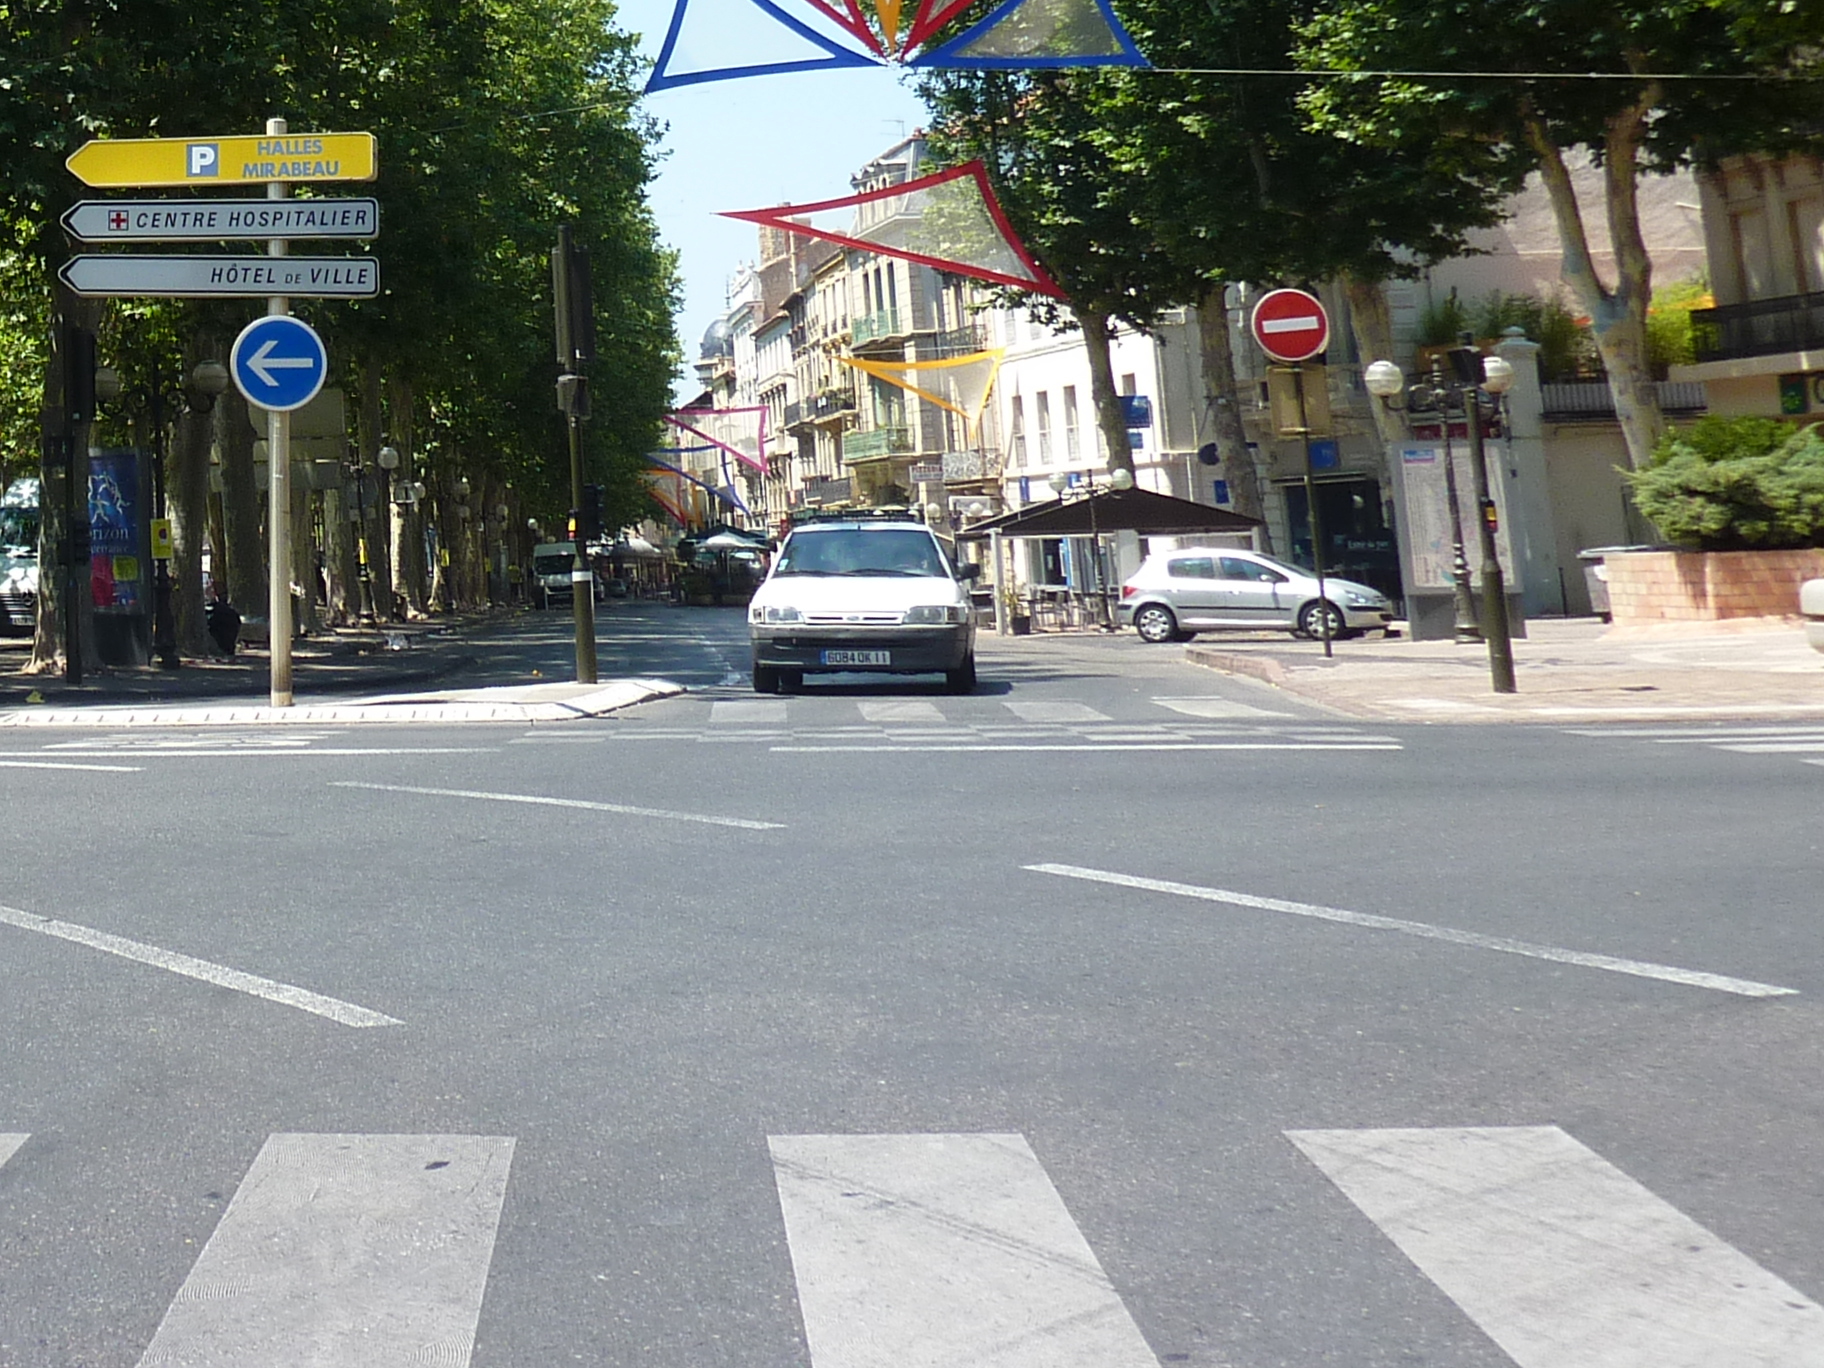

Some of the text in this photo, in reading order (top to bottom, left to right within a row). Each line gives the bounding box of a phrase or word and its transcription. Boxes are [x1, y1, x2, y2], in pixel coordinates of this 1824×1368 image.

[191, 139, 323, 175] P HALLES
[243, 161, 340, 178] MIRABEAU
[136, 210, 367, 229] CENTRE HOSPITALIER
[211, 263, 368, 285] HÔTEL DE VILLE
[90, 527, 129, 540] rizon
